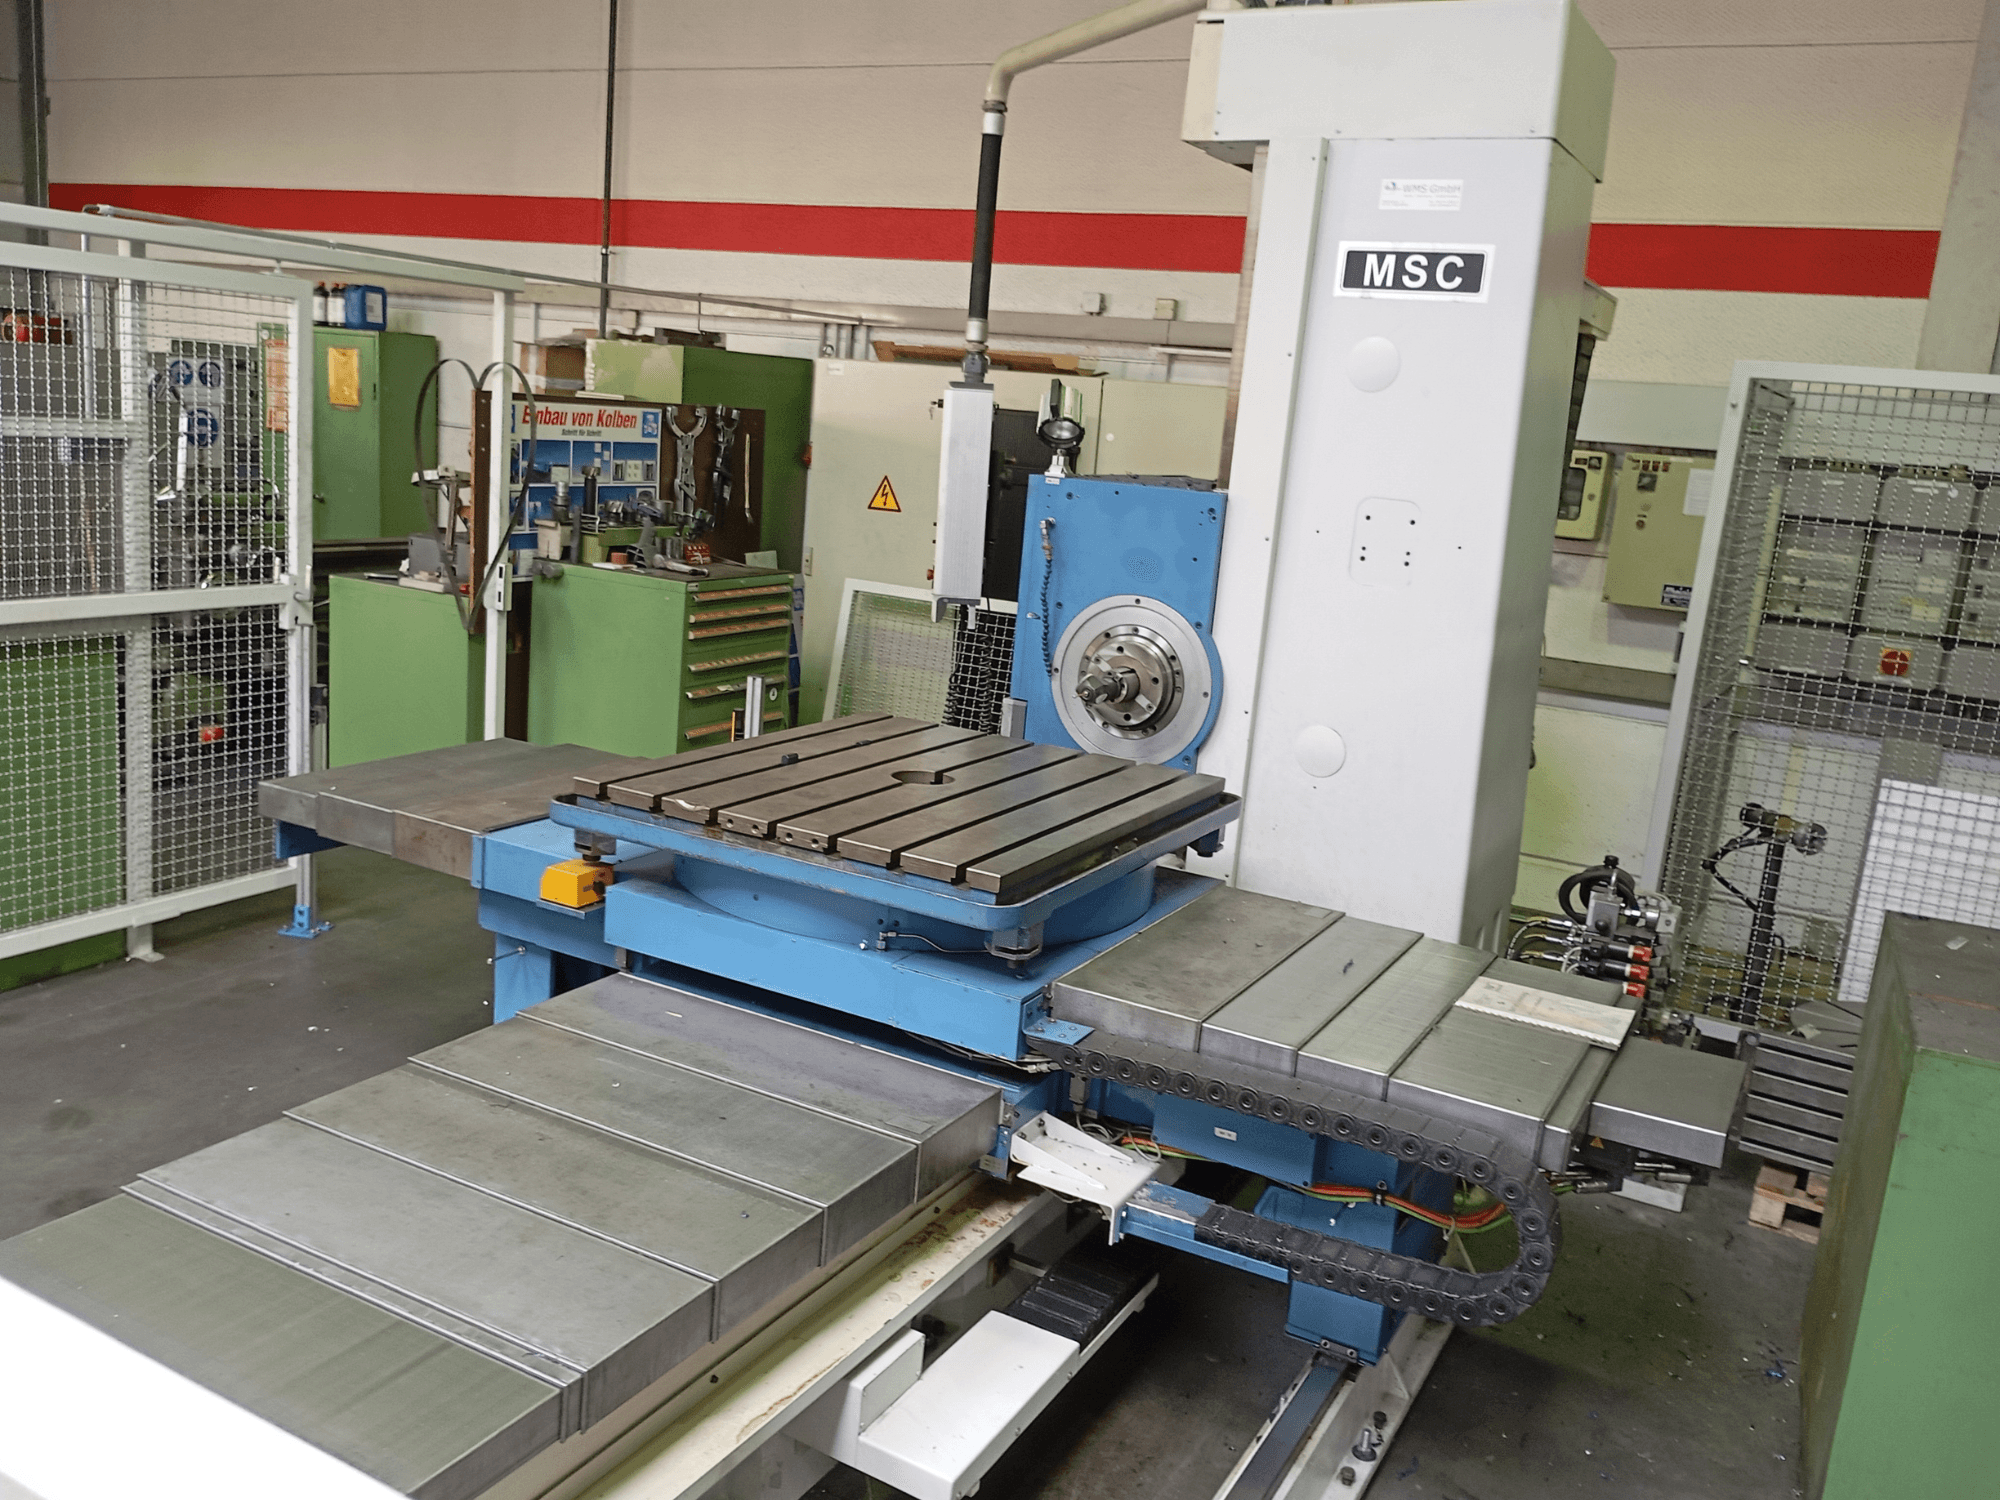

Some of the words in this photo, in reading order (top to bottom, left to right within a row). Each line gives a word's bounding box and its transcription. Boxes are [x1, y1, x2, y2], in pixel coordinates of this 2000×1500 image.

[1363, 253, 1465, 290] MSC
[522, 405, 568, 426] Enbau
[572, 411, 594, 427] von
[597, 409, 638, 429] Kolben
